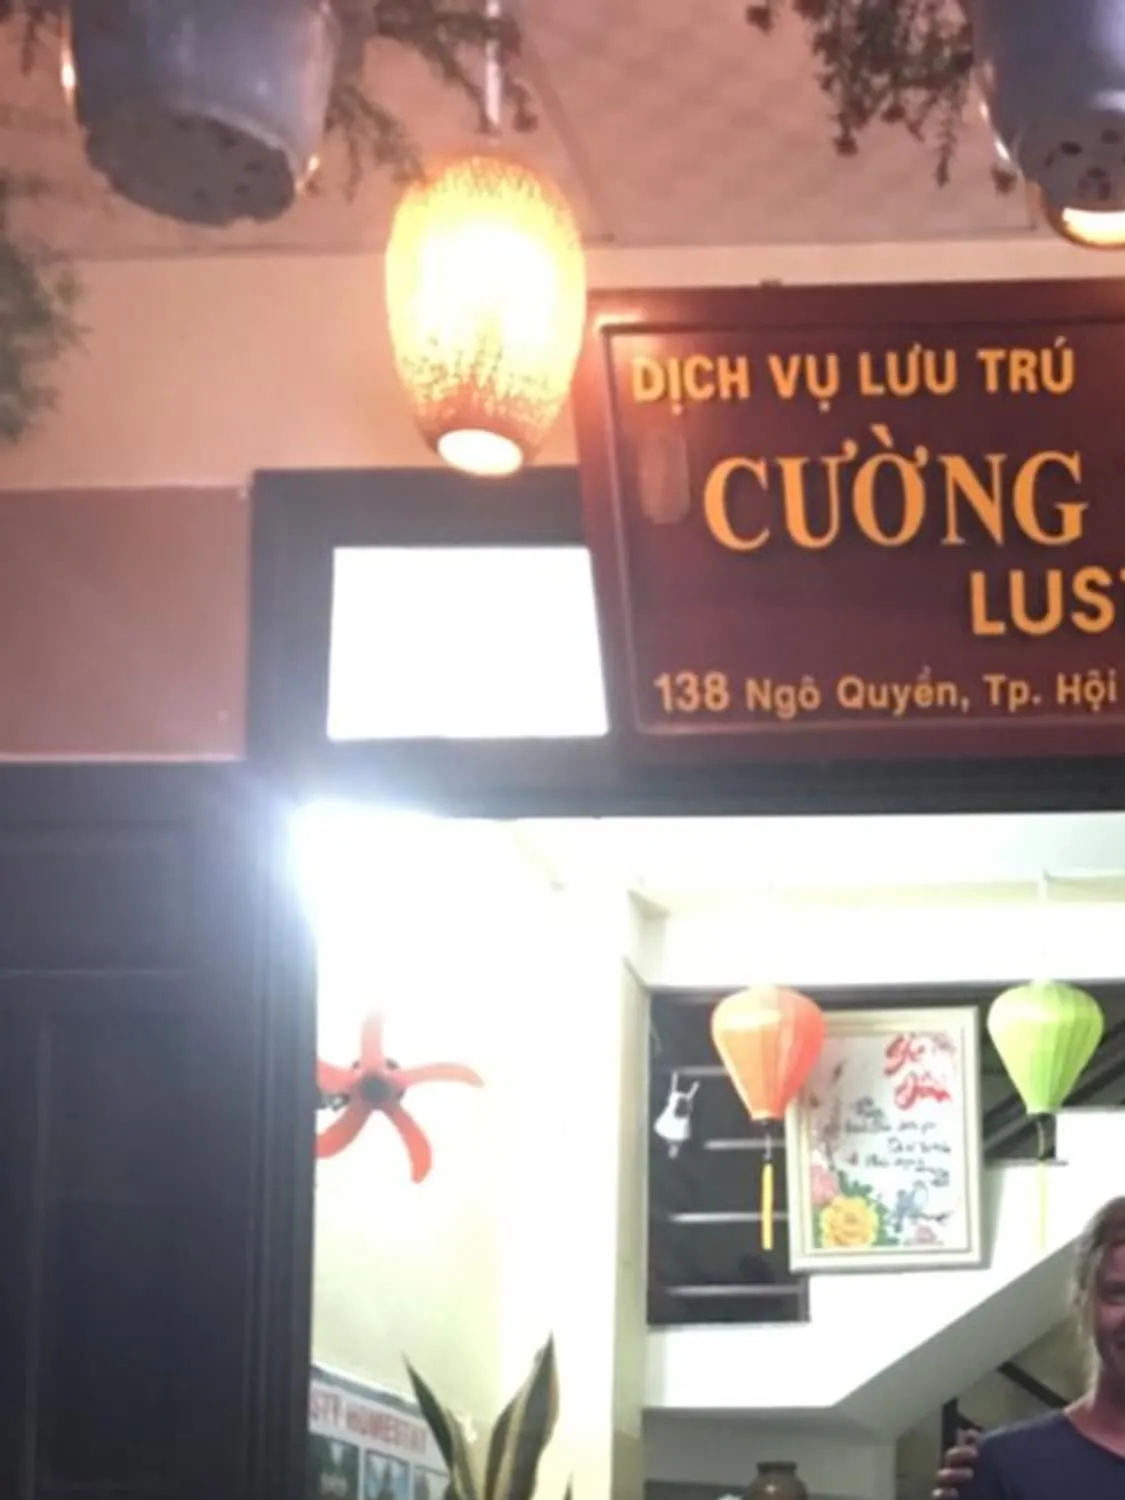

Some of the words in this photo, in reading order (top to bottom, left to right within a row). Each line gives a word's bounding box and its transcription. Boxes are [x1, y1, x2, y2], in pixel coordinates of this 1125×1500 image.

[632, 354, 750, 415] DỊCH
[767, 353, 840, 412] VỤ
[858, 342, 957, 396] LƯU
[976, 335, 1074, 394] TRÚ
[704, 423, 1088, 551] CƯỜNG
[654, 671, 730, 714] 138
[746, 674, 821, 719] Ngô
[983, 673, 1042, 713] Tp.
[1056, 669, 1117, 712] Hội
